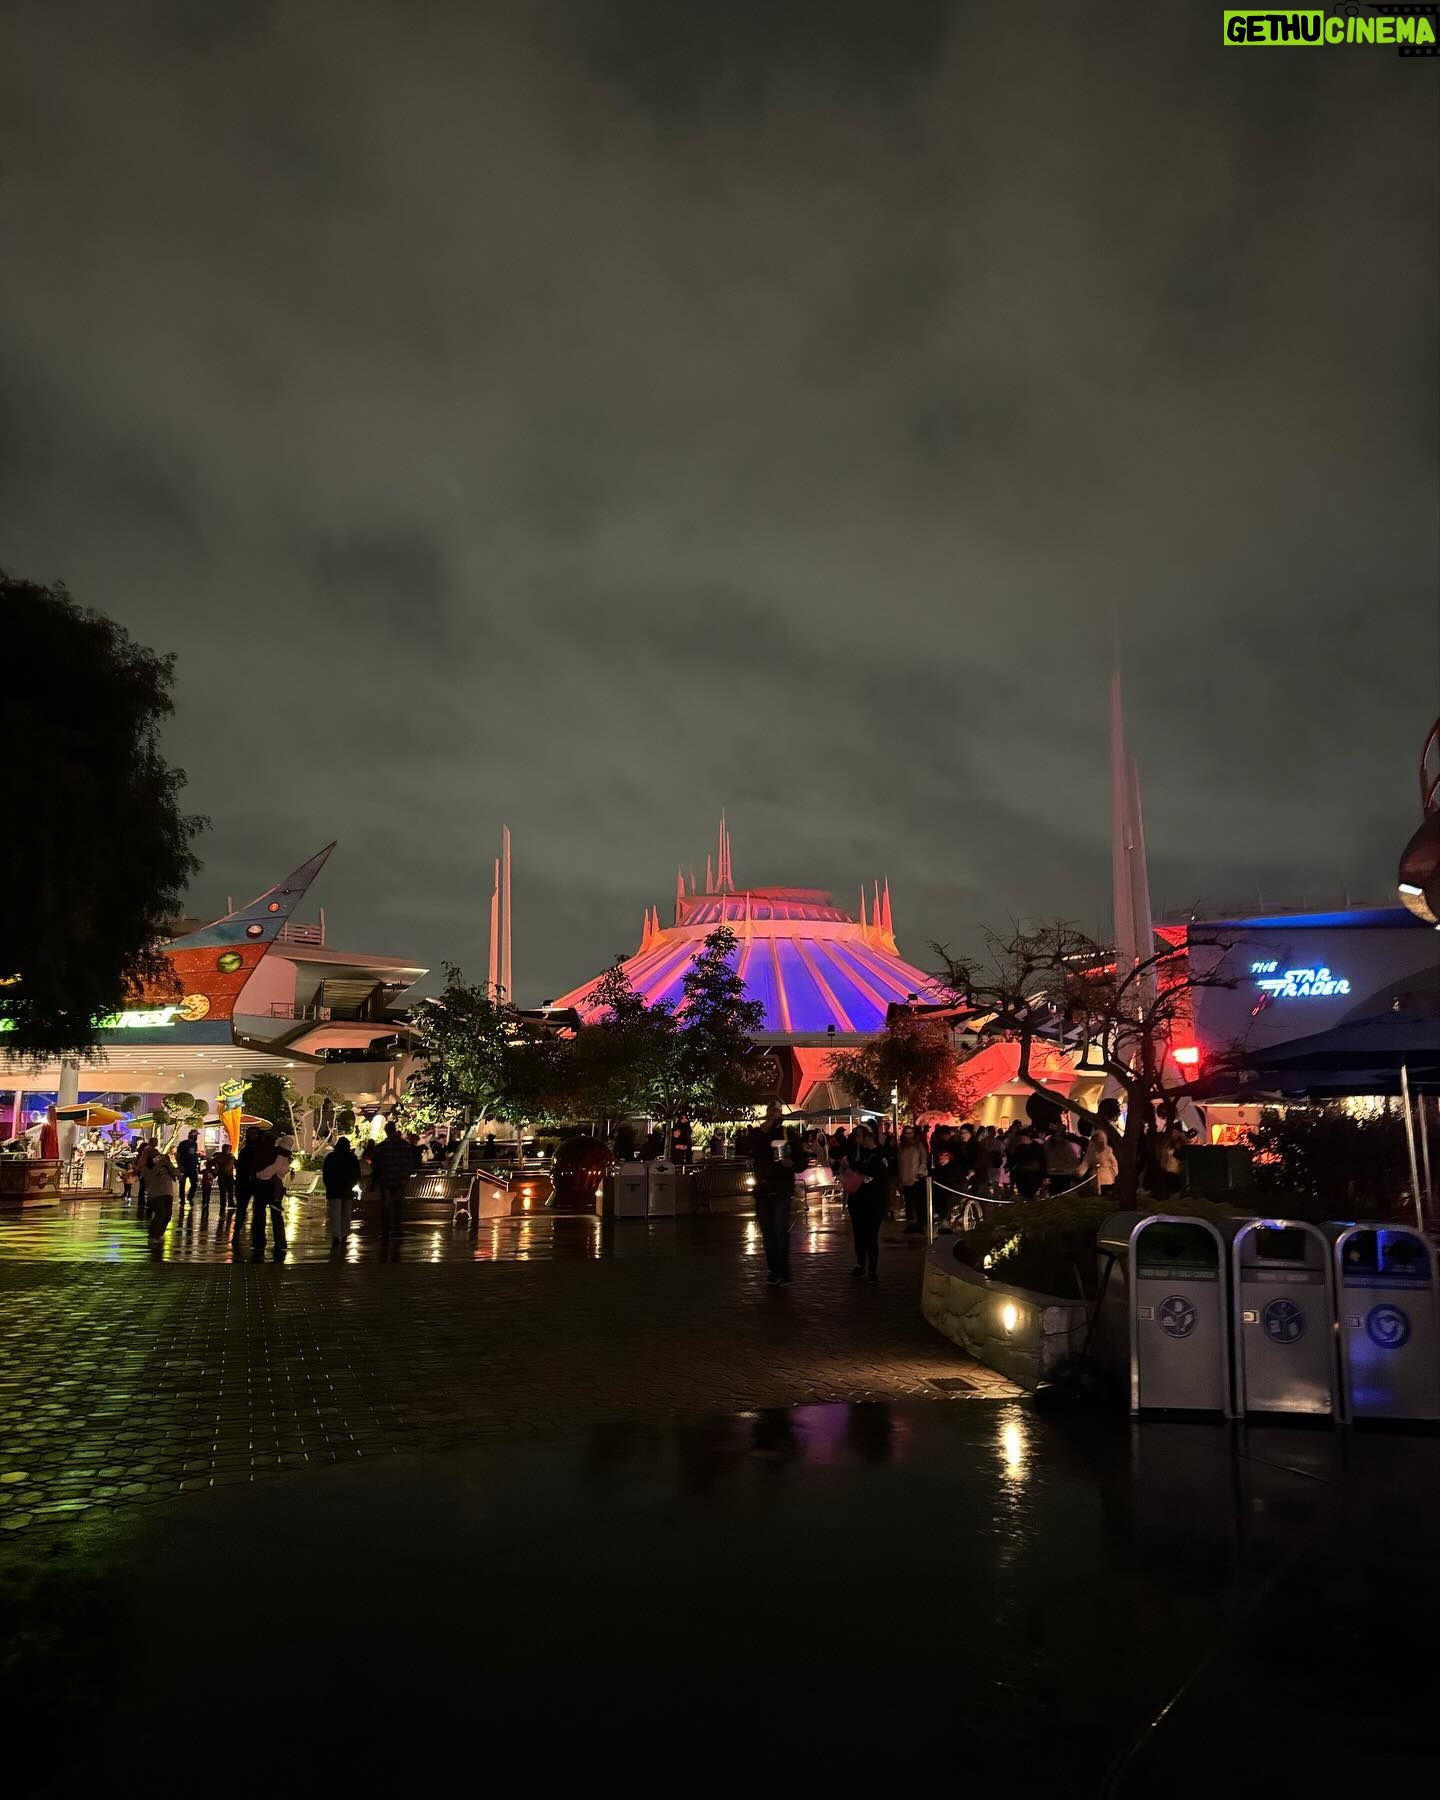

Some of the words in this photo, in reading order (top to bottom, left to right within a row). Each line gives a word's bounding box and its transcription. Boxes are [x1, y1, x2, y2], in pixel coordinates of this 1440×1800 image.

[1250, 961, 1279, 974] THE
[1283, 967, 1333, 985] STAR
[1260, 979, 1351, 998] TRADER
